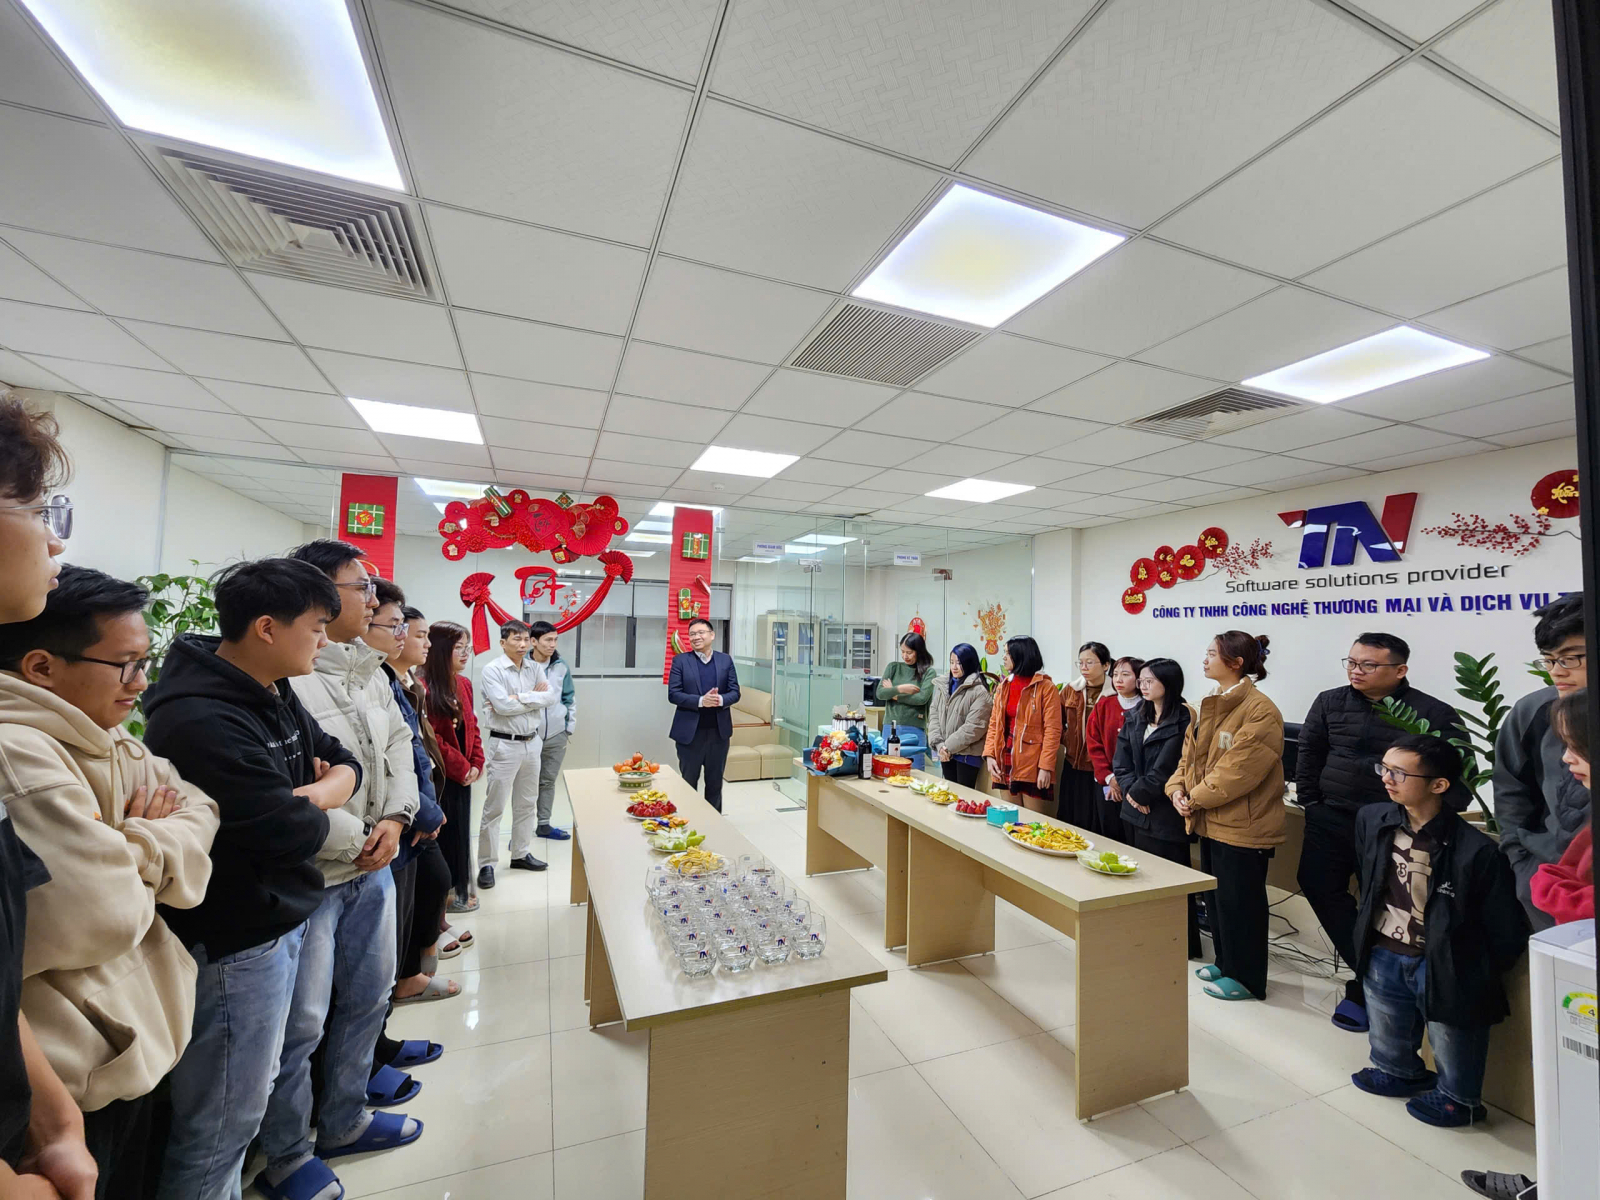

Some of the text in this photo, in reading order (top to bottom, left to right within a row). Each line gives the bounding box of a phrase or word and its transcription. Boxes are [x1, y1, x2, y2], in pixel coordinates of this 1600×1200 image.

[1225, 563, 1513, 593] Software solutions provider
[1152, 604, 1180, 618] CÔNG
[1183, 606, 1195, 618] TY
[1199, 605, 1228, 617] TNHH
[1232, 602, 1267, 616] CÔNG
[1271, 599, 1309, 618] NGHỆ
[1314, 598, 1378, 615] THƯƠNG
[1386, 597, 1421, 616] MẠI
[1428, 593, 1454, 613] VÀ
[1461, 593, 1512, 615] DỊCH
[1218, 731, 1233, 750] R
[1588, 1008, 1596, 1017] 4
